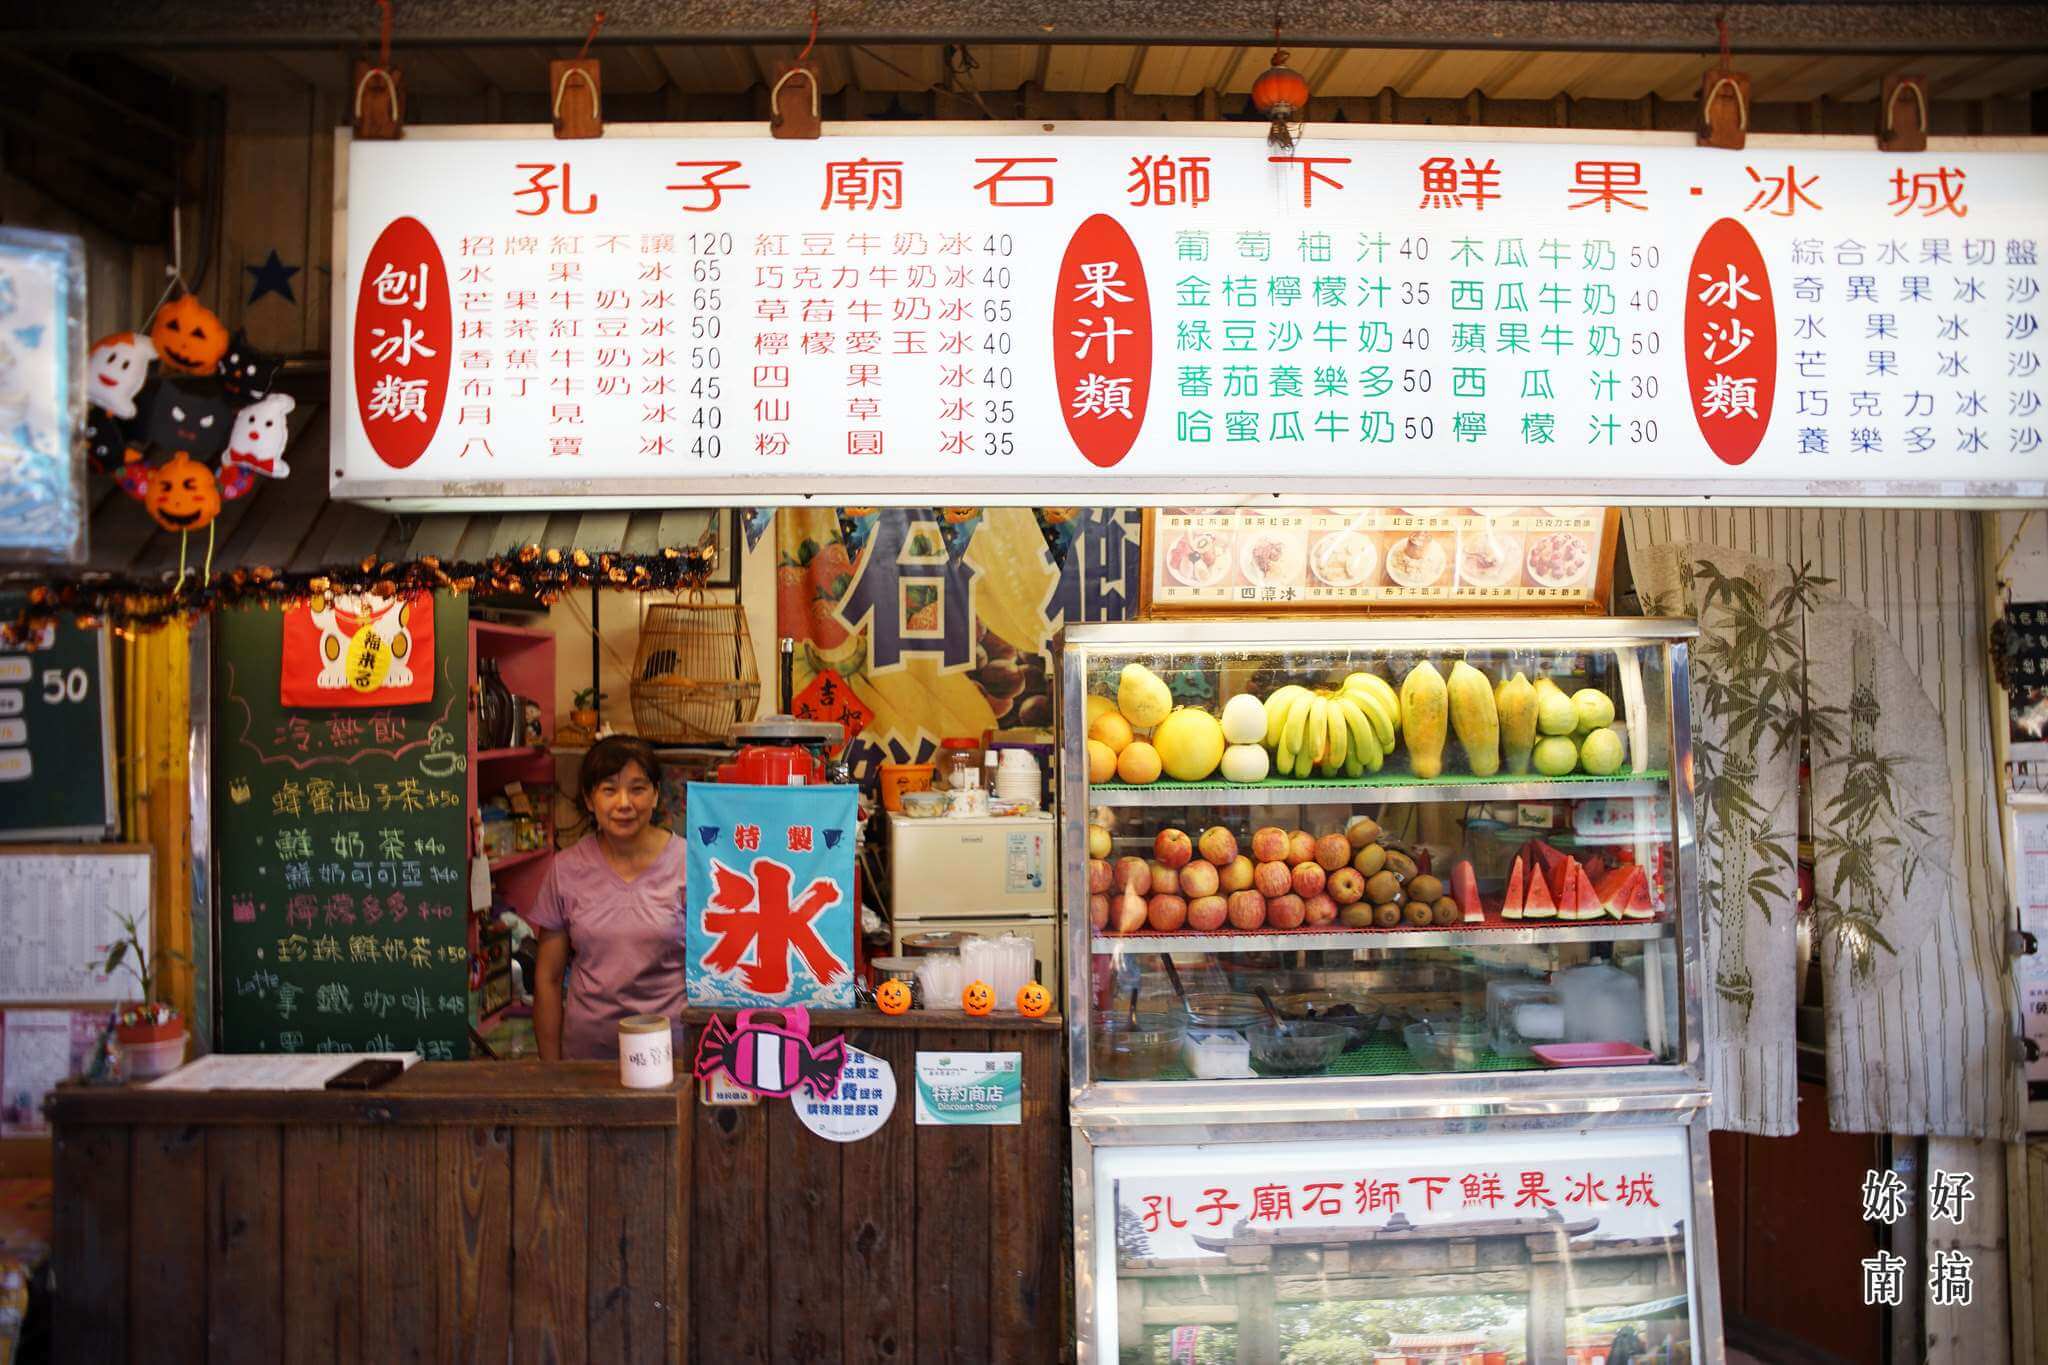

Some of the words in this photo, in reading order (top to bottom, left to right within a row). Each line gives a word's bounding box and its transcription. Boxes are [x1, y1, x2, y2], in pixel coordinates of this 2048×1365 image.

[459, 232, 675, 257] 招牌紅不讓
[687, 231, 734, 257] 120
[754, 232, 973, 257] 紅豆牛奶冰
[982, 233, 1014, 257] 40
[1174, 229, 1392, 264] 葡萄柚汁
[1399, 235, 1429, 262] 40
[1449, 236, 1617, 272] 木瓜牛奶
[1629, 245, 1661, 269] 50
[1791, 238, 2038, 266] 綜合水果切盤
[458, 261, 673, 283] 水果冰
[692, 259, 721, 283] 65
[754, 264, 975, 289] 巧克力牛奶冰
[982, 266, 1014, 290] 40
[692, 288, 721, 311] 65
[1175, 272, 1393, 310] 金桔檸檬汁
[1400, 281, 1432, 306] 35
[1449, 278, 1617, 317] 西瓜牛奶
[1629, 288, 1660, 313] 40
[1792, 274, 2041, 304] 奇異果冰沙
[753, 296, 976, 324] 草莓牛奶冰
[983, 299, 1015, 323] 65
[691, 316, 721, 340] 50
[1071, 261, 1135, 420] 果汁類
[1175, 318, 1394, 354] 綠豆沙牛奶
[1401, 327, 1432, 352] 40
[1449, 319, 1623, 358] 蘋果牛奶
[1630, 330, 1661, 357] 50
[1793, 311, 2040, 341] 水果冰沙
[368, 262, 437, 423] 刨冰類
[753, 330, 974, 357] 檸檬愛玉冰
[983, 331, 1013, 355] 40
[1698, 264, 1761, 419] 冰沙類
[691, 346, 721, 370] 50
[1794, 349, 2042, 378] 芒果冰沙
[459, 375, 676, 399] 布丁牛奶冰
[688, 376, 721, 401] 45
[751, 362, 976, 389] 四果冰
[982, 366, 1014, 391] 40
[1176, 362, 1395, 401] 蕃茄養樂多
[1402, 366, 1433, 393] 50
[1450, 366, 1623, 403] 西瓜汁
[1630, 375, 1659, 401] 30
[457, 400, 677, 426] 月見冰
[687, 405, 721, 430] 40
[752, 396, 976, 424] 仙草冰
[983, 399, 1015, 424] 35
[1796, 388, 2043, 418] 巧克力冰沙
[1175, 407, 1396, 445] 哈蜜瓜牛奶
[1403, 415, 1436, 440] 50
[1451, 409, 1623, 447] 檸檬汁
[1629, 419, 1659, 446] 30
[1797, 425, 2044, 456] 養樂多冰沙
[458, 432, 675, 459] 八寶冰
[690, 434, 722, 460] 40
[751, 429, 976, 457] 粉圓冰
[983, 431, 1014, 457] 35
[43, 667, 88, 703] 50
[272, 777, 424, 818] 蜂蜜柚子茶
[275, 828, 406, 859] 鮮奶茶
[734, 824, 814, 853] 特製
[284, 861, 424, 890] 鮮奶可可亞
[277, 934, 432, 969] 珍珠鮮奶茶
[276, 982, 432, 1021] 拿鐵咖啡
[931, 1084, 1005, 1103] 特約商店
[937, 1102, 975, 1112] Discount
[975, 1102, 999, 1113] Store
[1141, 1171, 1661, 1233] 孔子廟石獅下鮮果冰城
